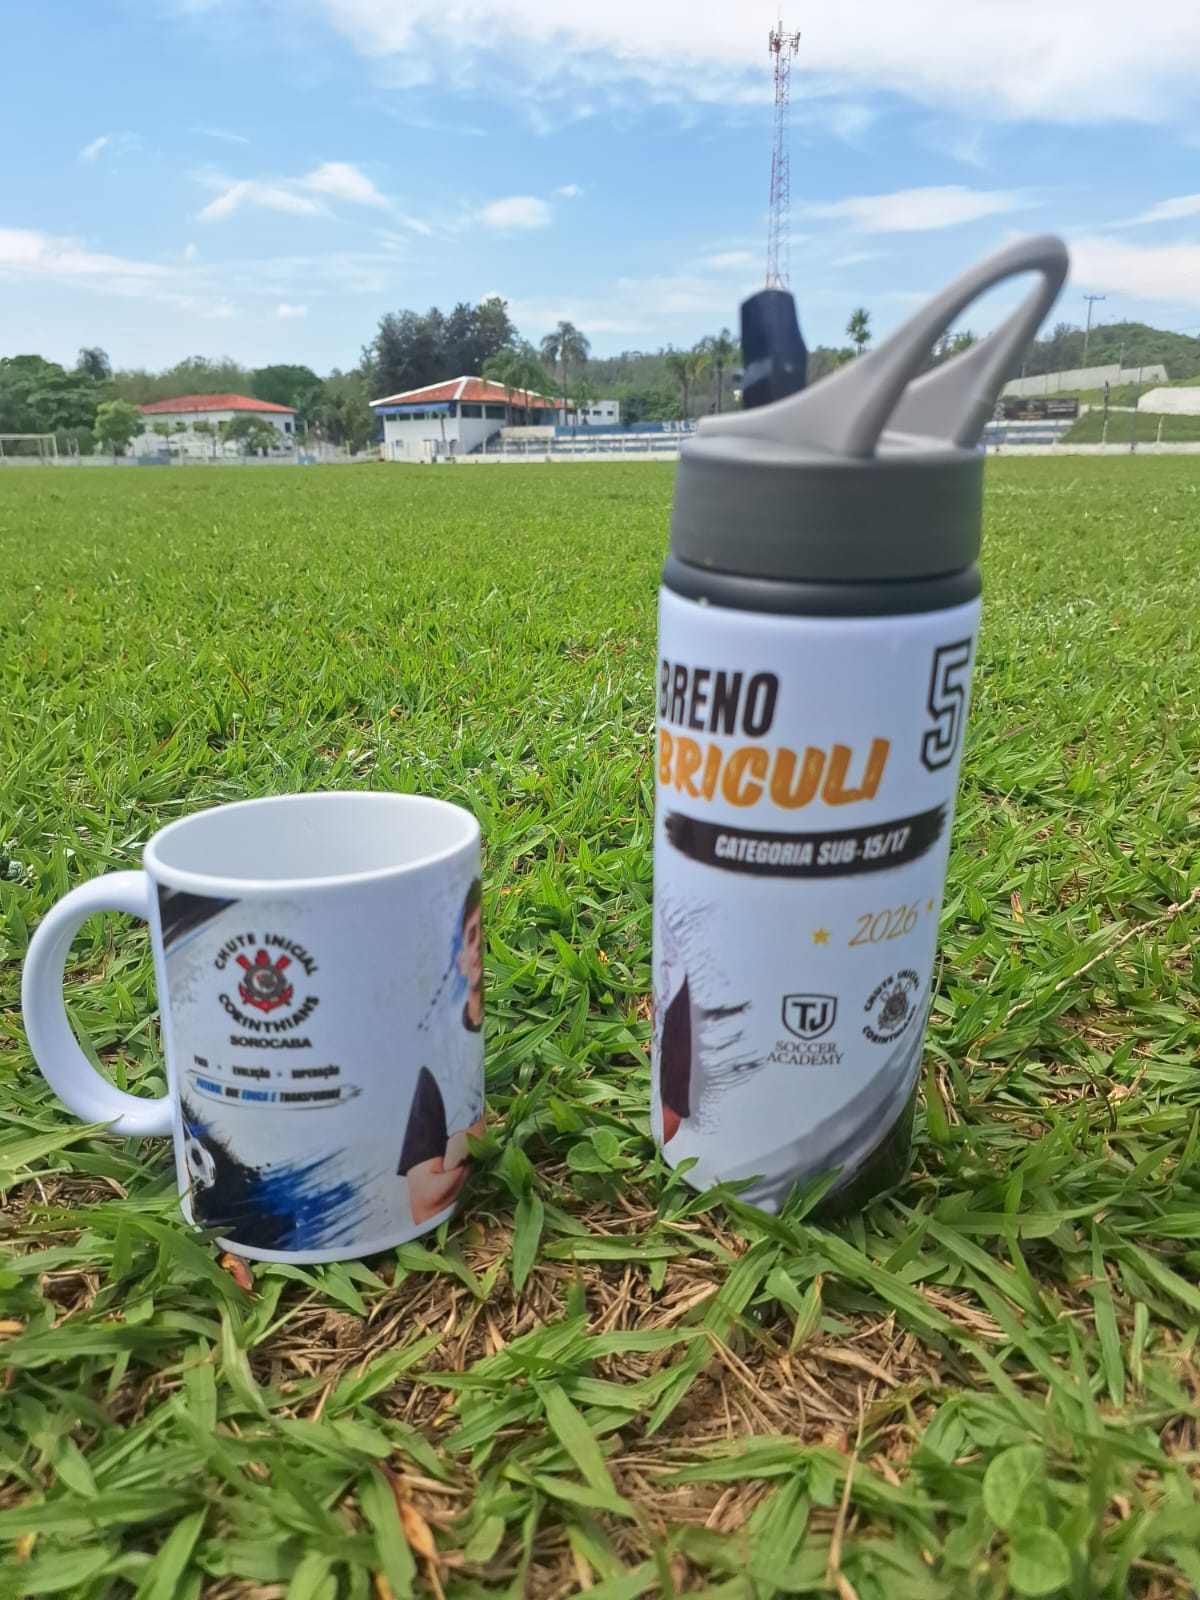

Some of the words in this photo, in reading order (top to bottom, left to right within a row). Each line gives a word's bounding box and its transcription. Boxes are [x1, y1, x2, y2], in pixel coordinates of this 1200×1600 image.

[660, 660, 779, 738] BRENO
[920, 637, 971, 773] 5
[714, 833, 814, 866] CATEGORIA
[848, 899, 920, 947] 2026
[214, 932, 256, 971] CHUTE
[264, 932, 319, 976] INICIAL
[218, 993, 320, 1033] CORINTHIANS
[791, 1001, 828, 1032] TJ
[229, 1035, 313, 1049] SOROCABA
[766, 1051, 844, 1066] ACADEMY
[774, 1040, 836, 1054] SOCCER
